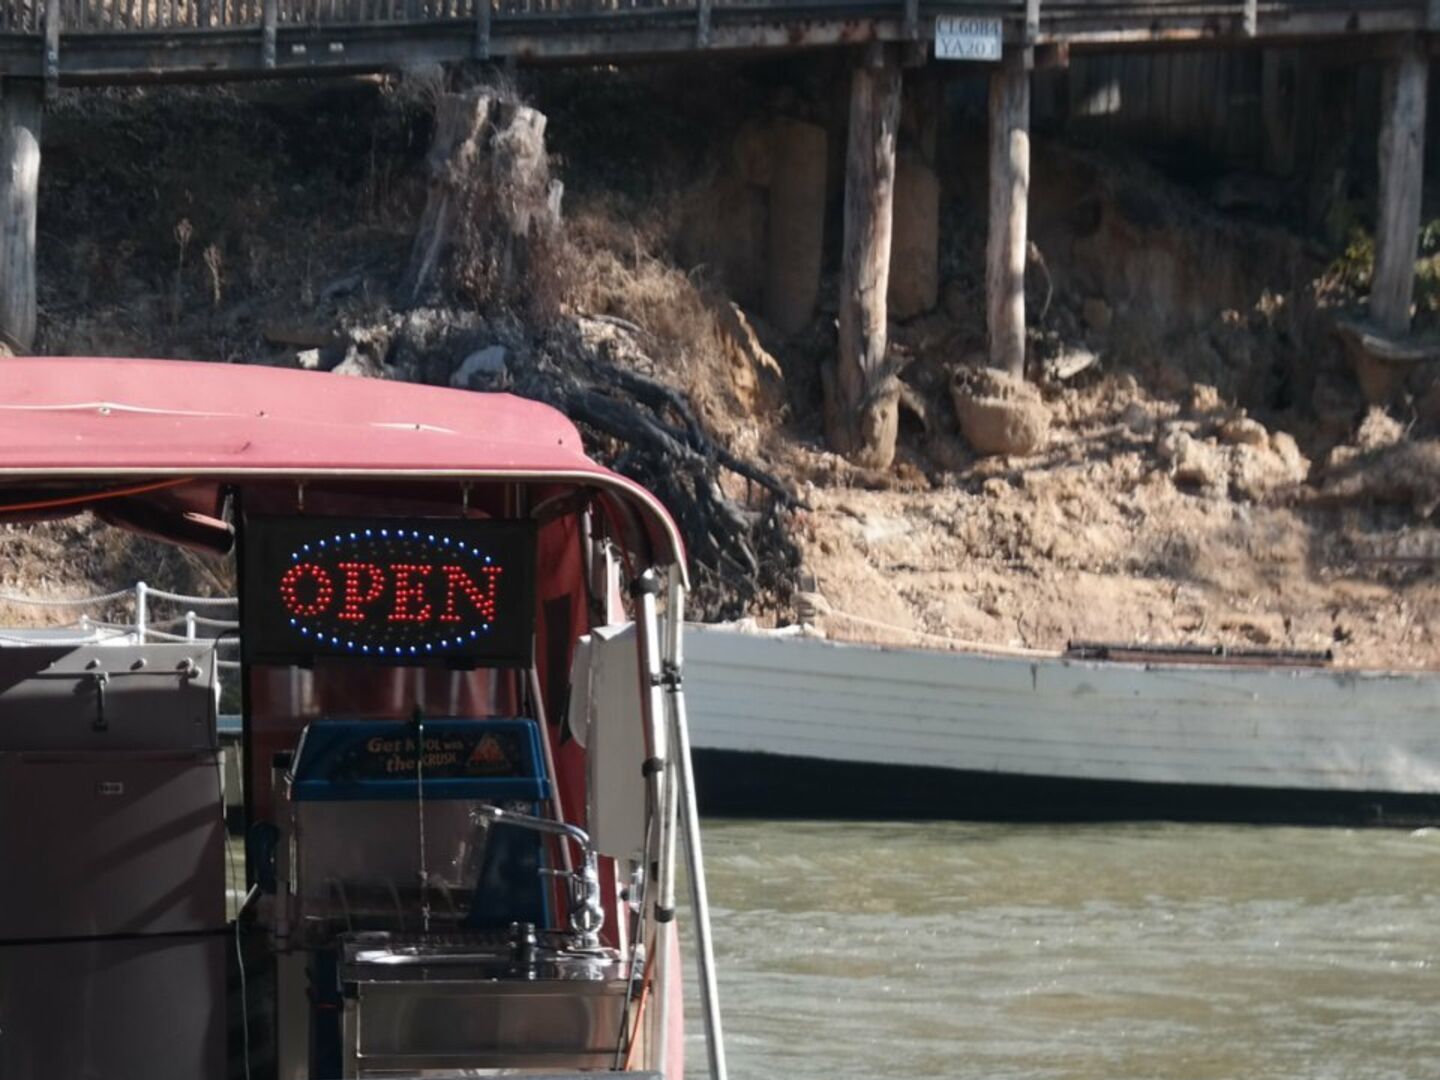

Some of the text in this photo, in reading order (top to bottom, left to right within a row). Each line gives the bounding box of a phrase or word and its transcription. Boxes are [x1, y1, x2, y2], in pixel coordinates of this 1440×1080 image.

[279, 563, 503, 622] OPEN
[367, 737, 402, 753] Get
[386, 753, 415, 772] the
